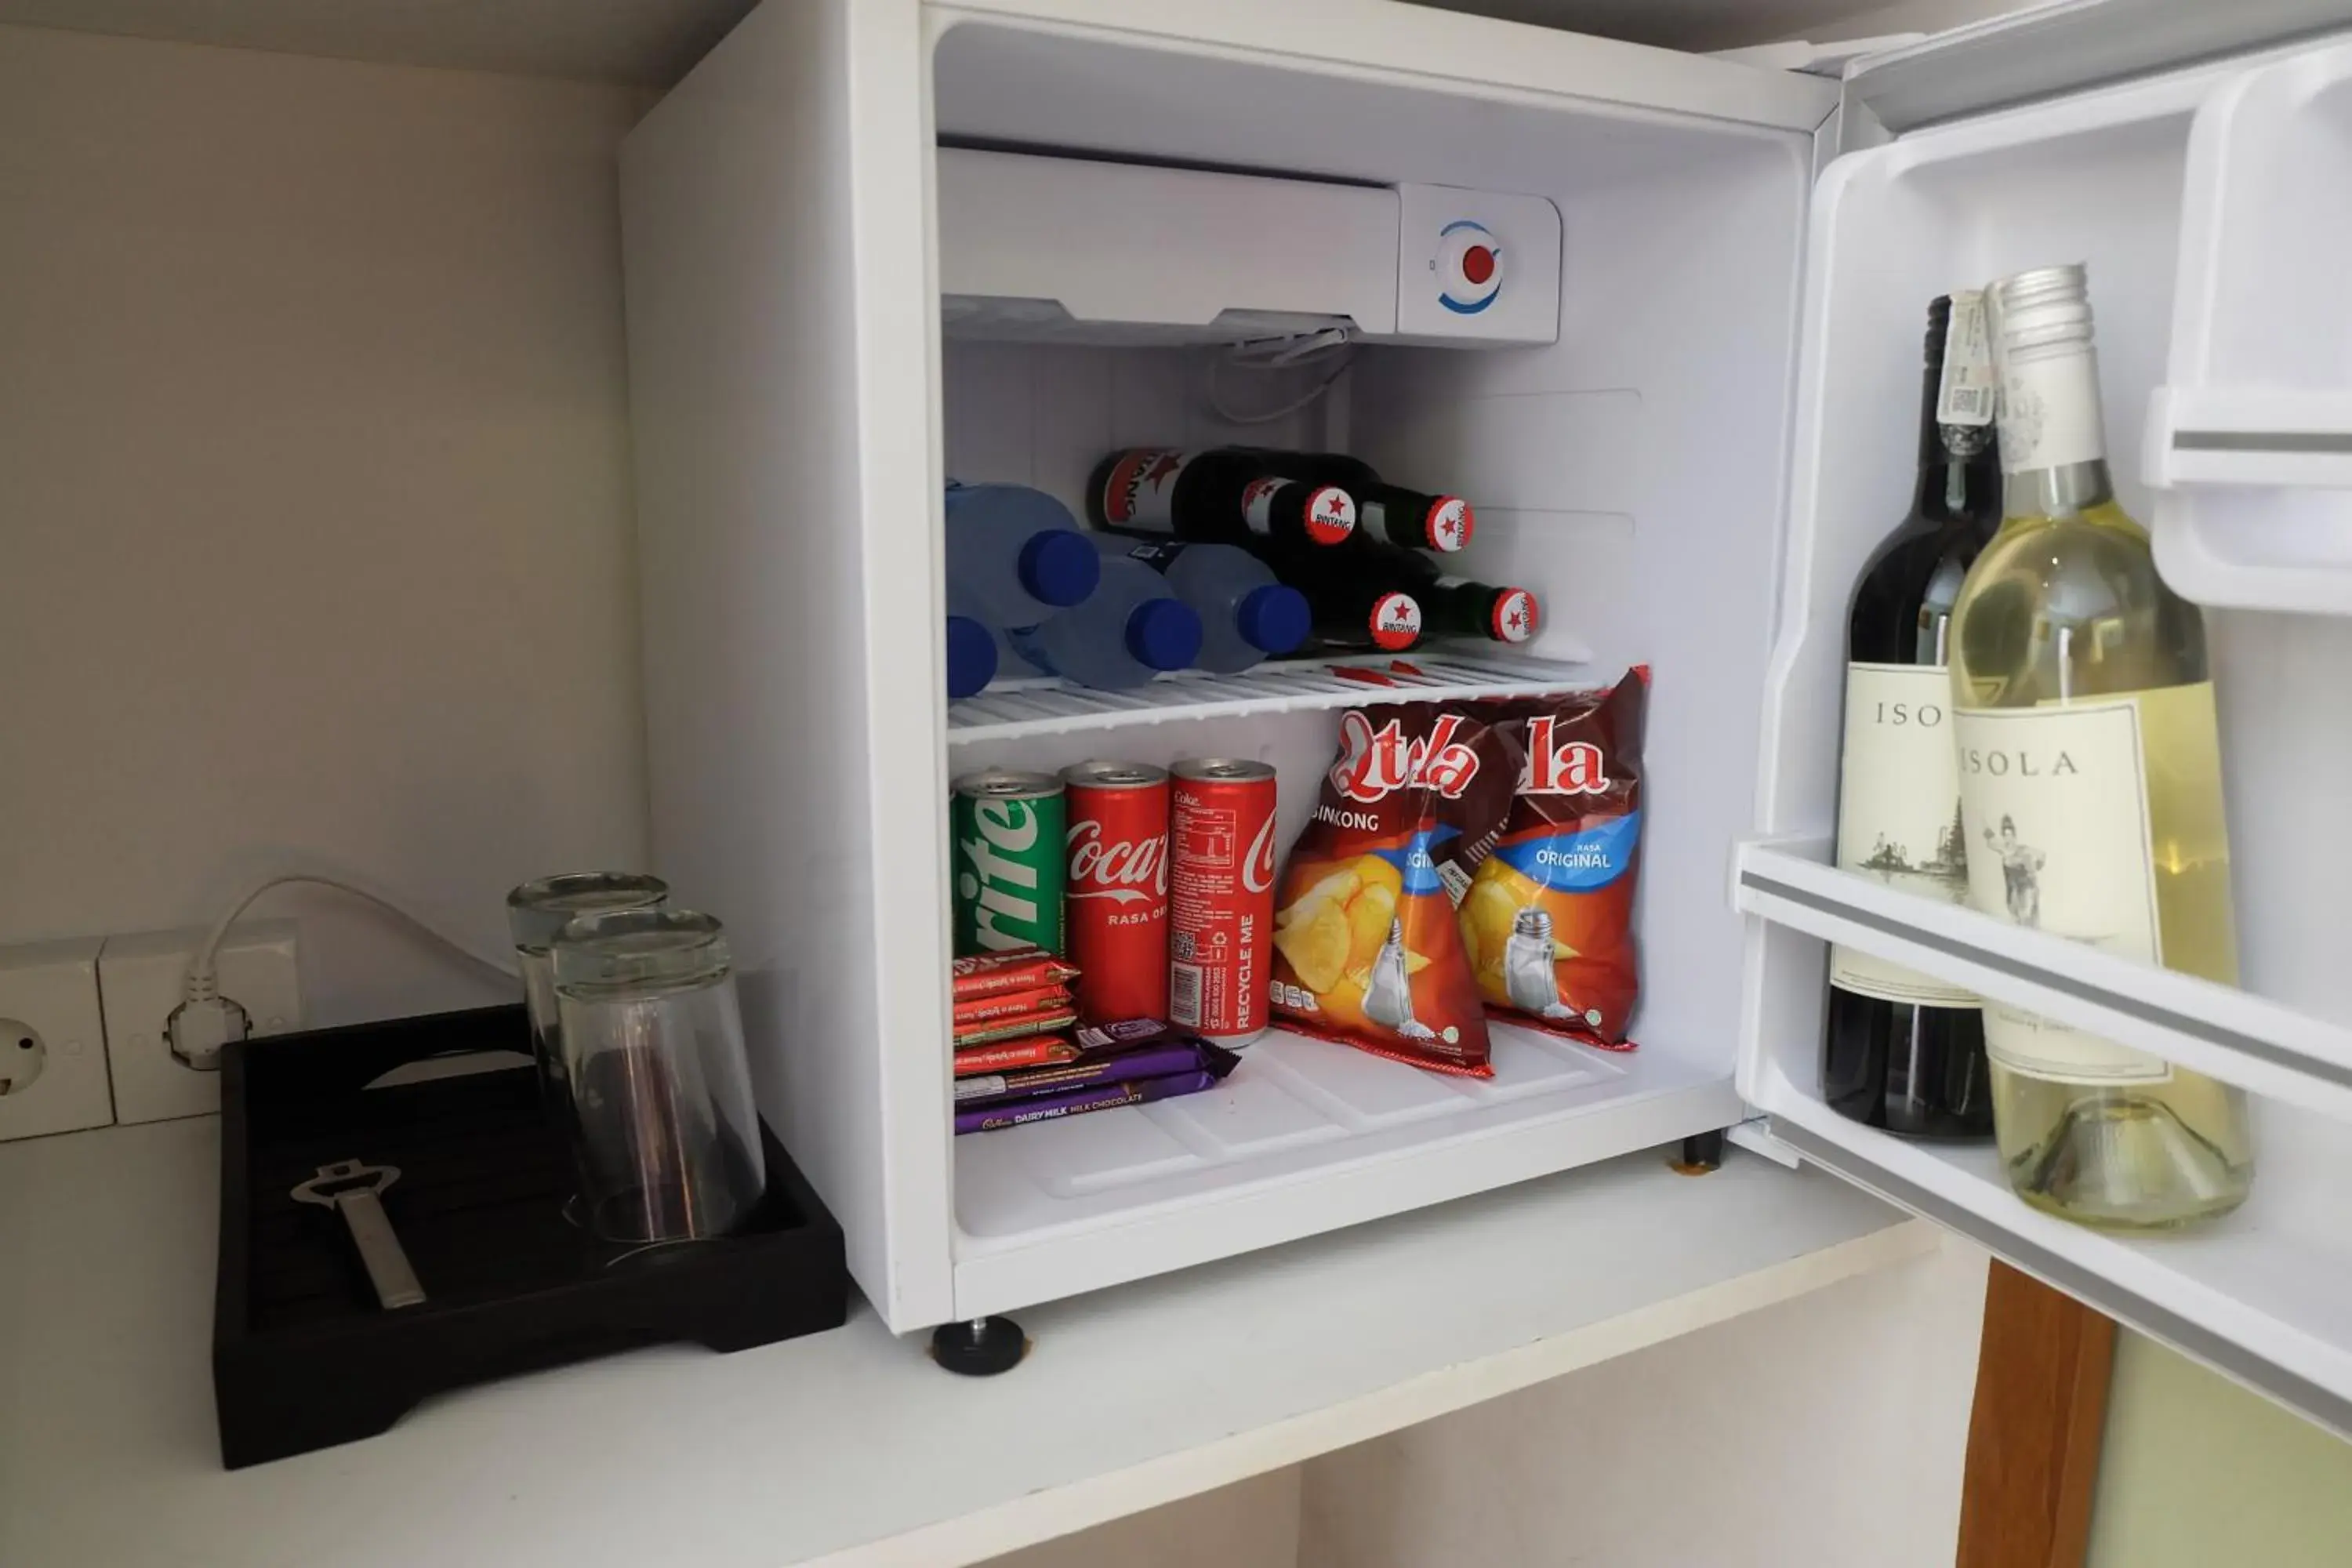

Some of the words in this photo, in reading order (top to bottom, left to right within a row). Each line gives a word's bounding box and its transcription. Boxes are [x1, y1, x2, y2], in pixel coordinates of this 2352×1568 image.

[1316, 514, 1351, 531] BINTANG
[1382, 622, 1417, 633] BINTANG
[1876, 702, 1942, 727] ISO
[1961, 747, 2079, 776] ISOLA
[1536, 849, 1612, 869] ORIGINAL
[1108, 912, 1149, 925] RASA
[1240, 914, 1254, 944] ME
[1237, 948, 1252, 1029] RECYCLE
[1015, 1109, 1044, 1123] DAIRY
[1045, 1106, 1067, 1117] MILK
[1070, 1104, 1091, 1114] MILK
